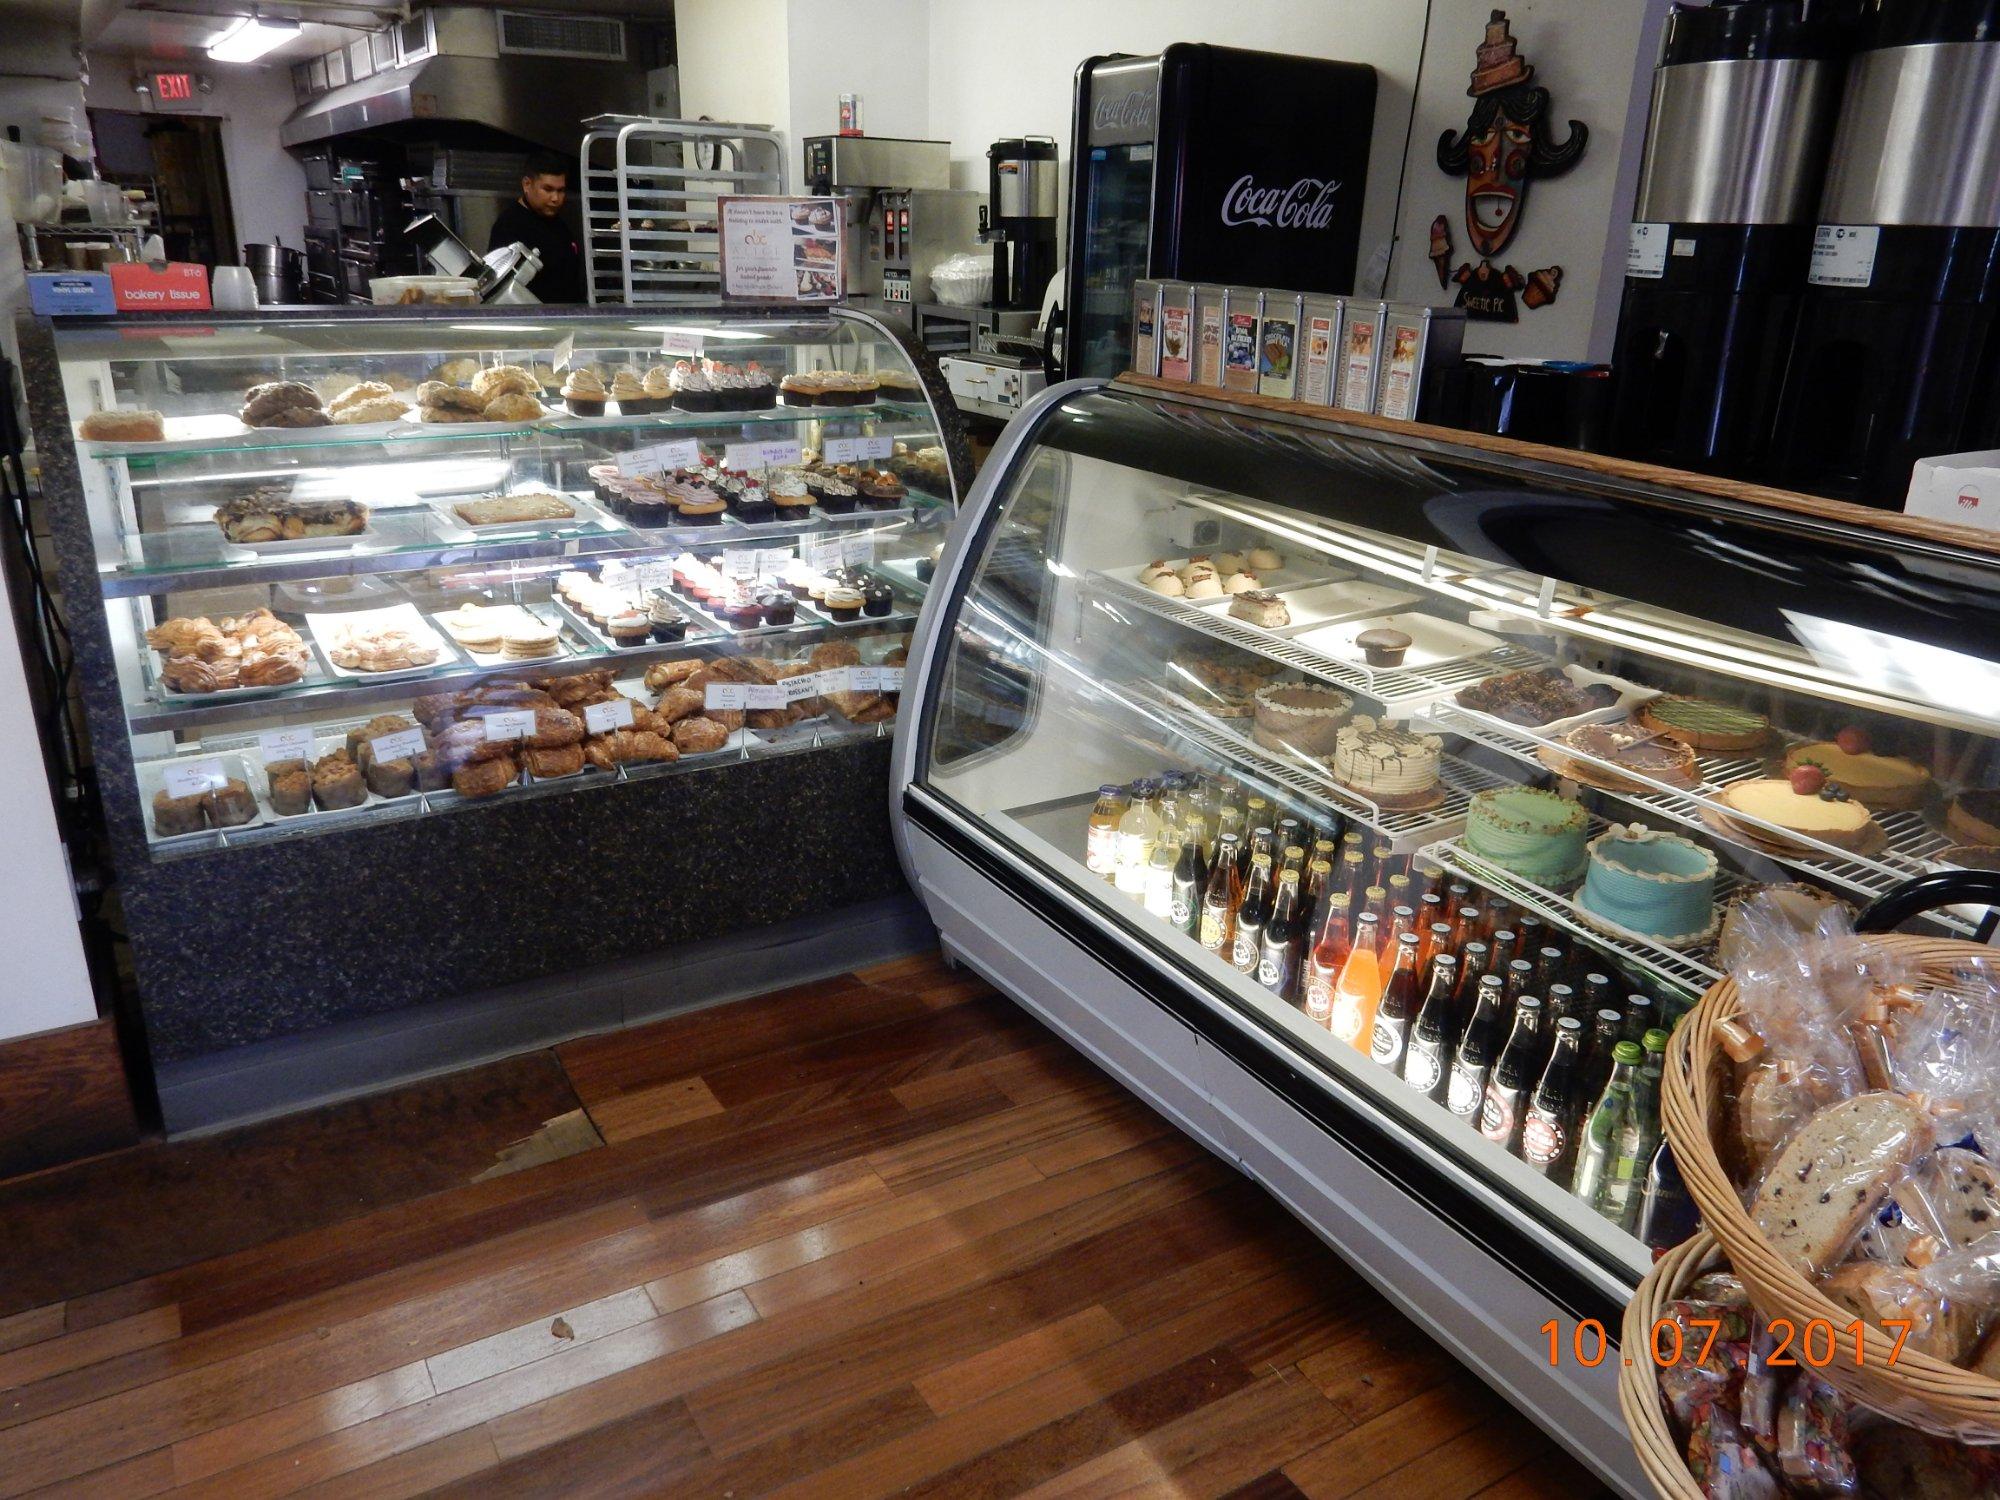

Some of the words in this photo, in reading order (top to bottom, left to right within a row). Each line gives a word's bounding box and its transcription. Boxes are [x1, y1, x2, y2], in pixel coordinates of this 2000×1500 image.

[156, 74, 191, 98] EXIT
[1221, 174, 1343, 229] Coca-Cola
[124, 289, 165, 301] bakery
[169, 289, 200, 300] tissue
